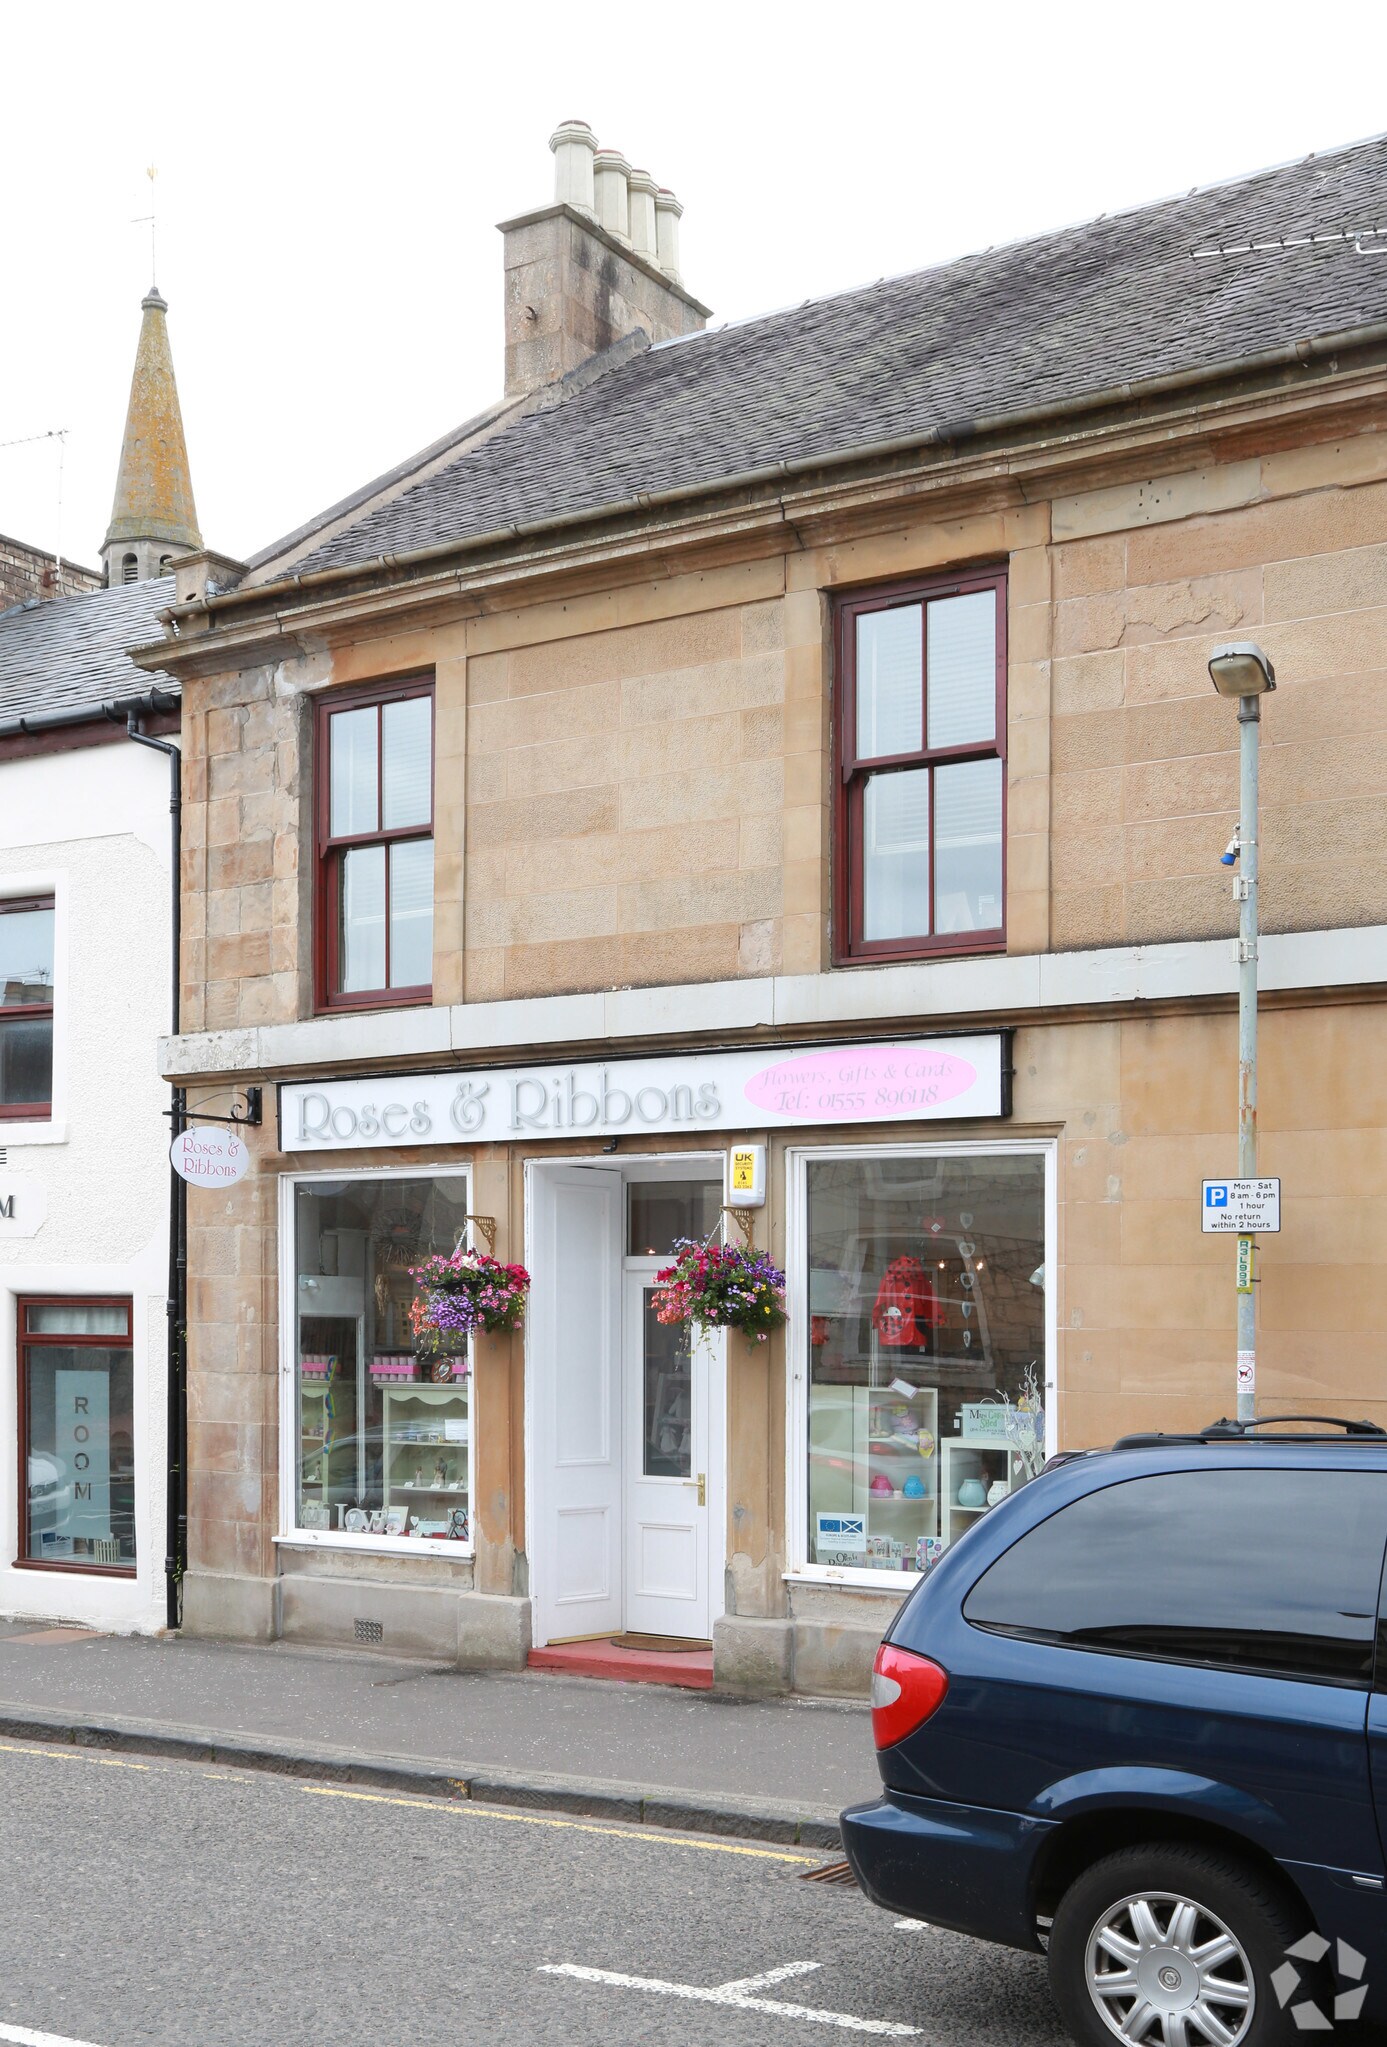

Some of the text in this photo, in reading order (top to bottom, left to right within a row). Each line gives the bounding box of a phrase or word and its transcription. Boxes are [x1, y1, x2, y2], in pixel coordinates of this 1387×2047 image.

[759, 1060, 953, 1090] Flowers, Gifts & Cards
[295, 1066, 721, 1141] Roses & Ribbons
[774, 1084, 939, 1111] Tel: 01555 896118
[183, 1137, 239, 1157] Roses &
[184, 1157, 237, 1177] Ribbons
[1211, 1188, 1225, 1206] P
[74, 1396, 91, 1500] ROOM
